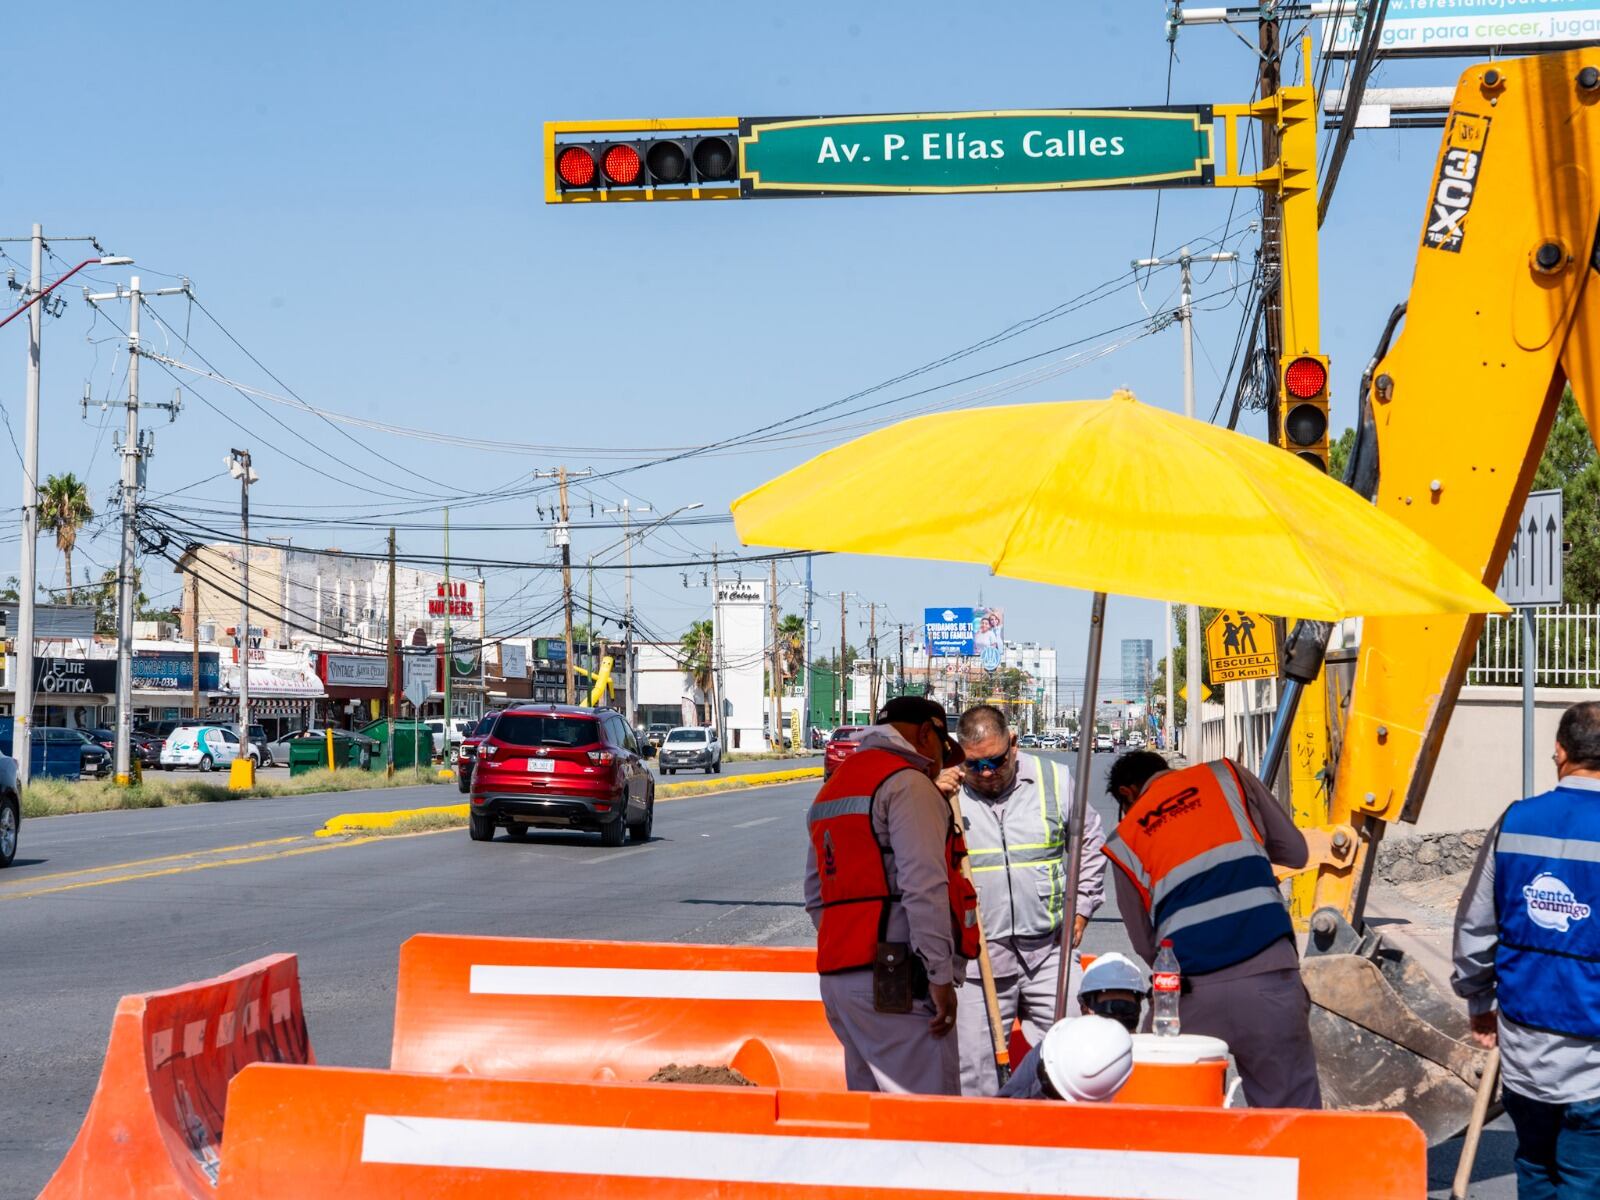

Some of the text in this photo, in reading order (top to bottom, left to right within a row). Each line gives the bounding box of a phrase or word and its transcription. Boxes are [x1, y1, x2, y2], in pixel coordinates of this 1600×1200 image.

[1422, 24, 1469, 43] para
[1475, 20, 1544, 38] crecer,
[817, 129, 1125, 164] Av. P. Elías Calles
[1215, 656, 1271, 668] ESCUELA
[43, 671, 94, 692] ÓPTICA
[1221, 671, 1235, 679] 30
[1524, 887, 1573, 903] cuenta
[1530, 899, 1589, 918] conmigo
